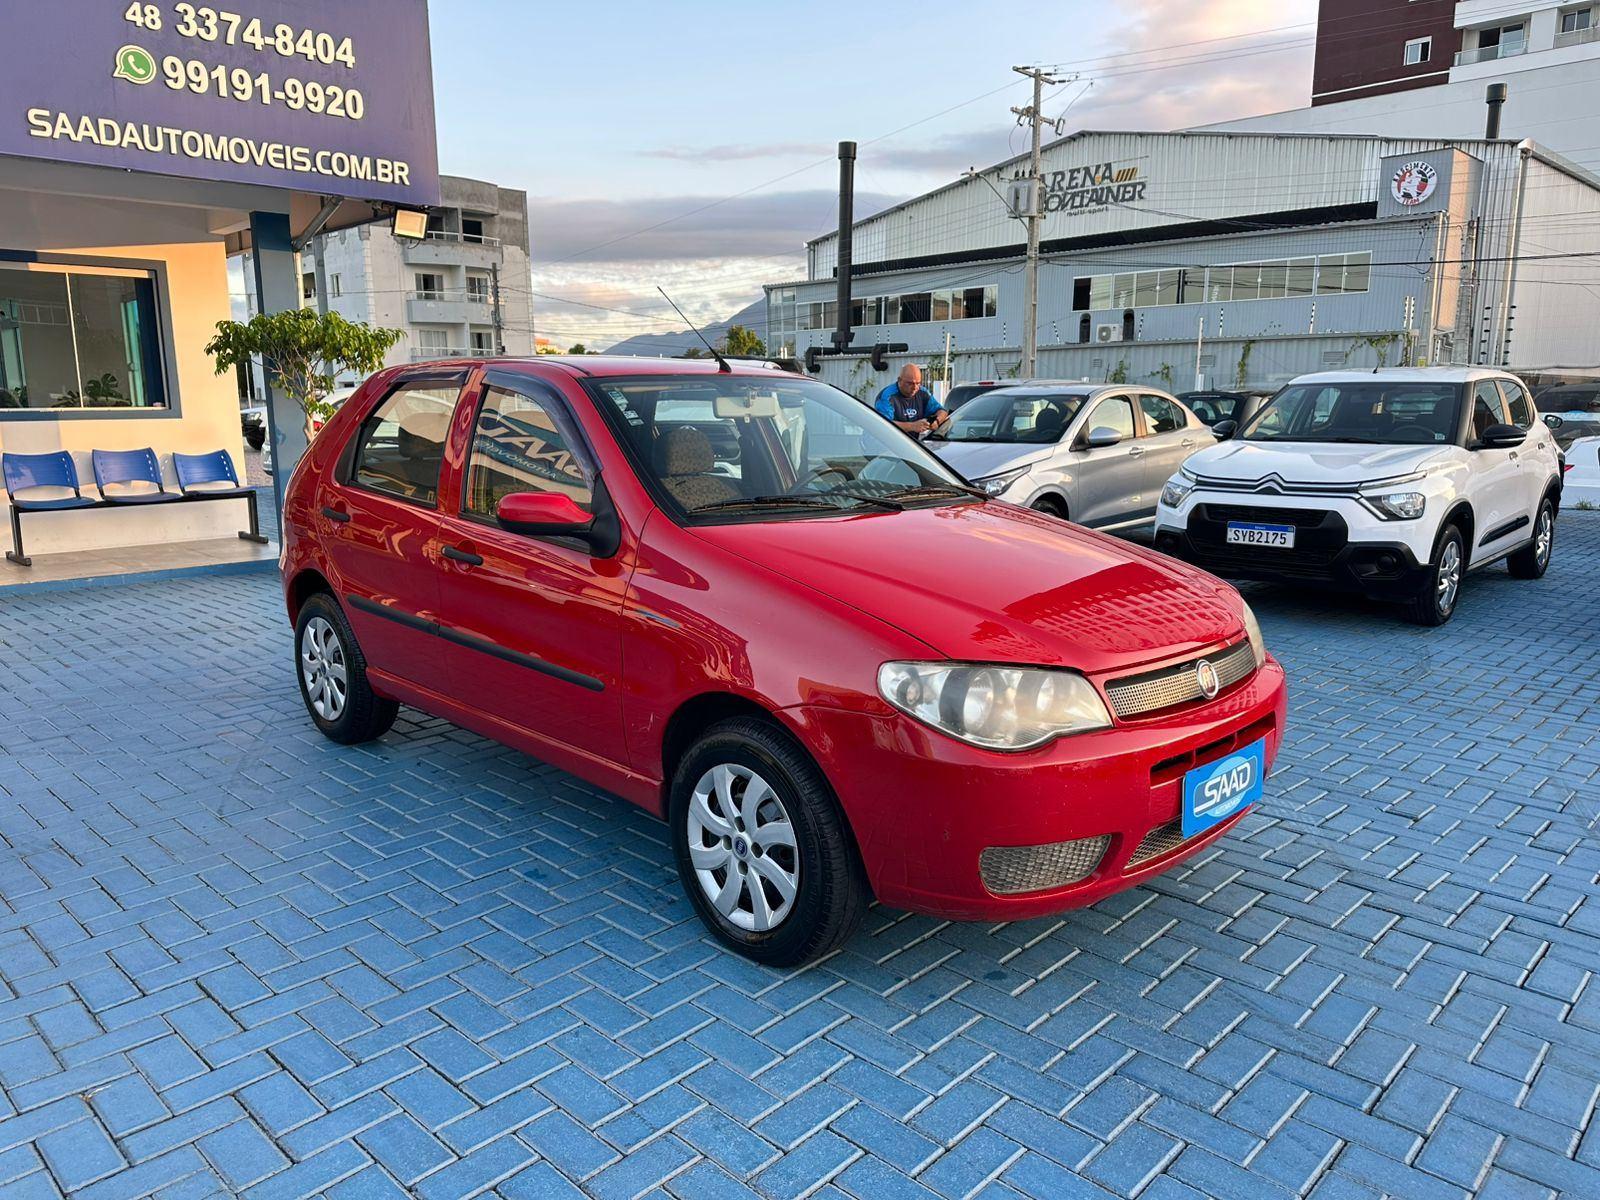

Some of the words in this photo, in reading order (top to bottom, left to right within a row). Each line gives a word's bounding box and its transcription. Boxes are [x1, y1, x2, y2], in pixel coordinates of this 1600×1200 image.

[125, 1, 162, 31] 48
[175, 2, 356, 68] 3374-8404
[162, 55, 364, 120] 99191-9920
[26, 108, 410, 186] SAADAUTOMOVEIS.COM.BR
[1044, 181, 1146, 213] ONTAINER
[1233, 529, 1287, 545] SYB2I75
[1194, 762, 1250, 813] SAAD
